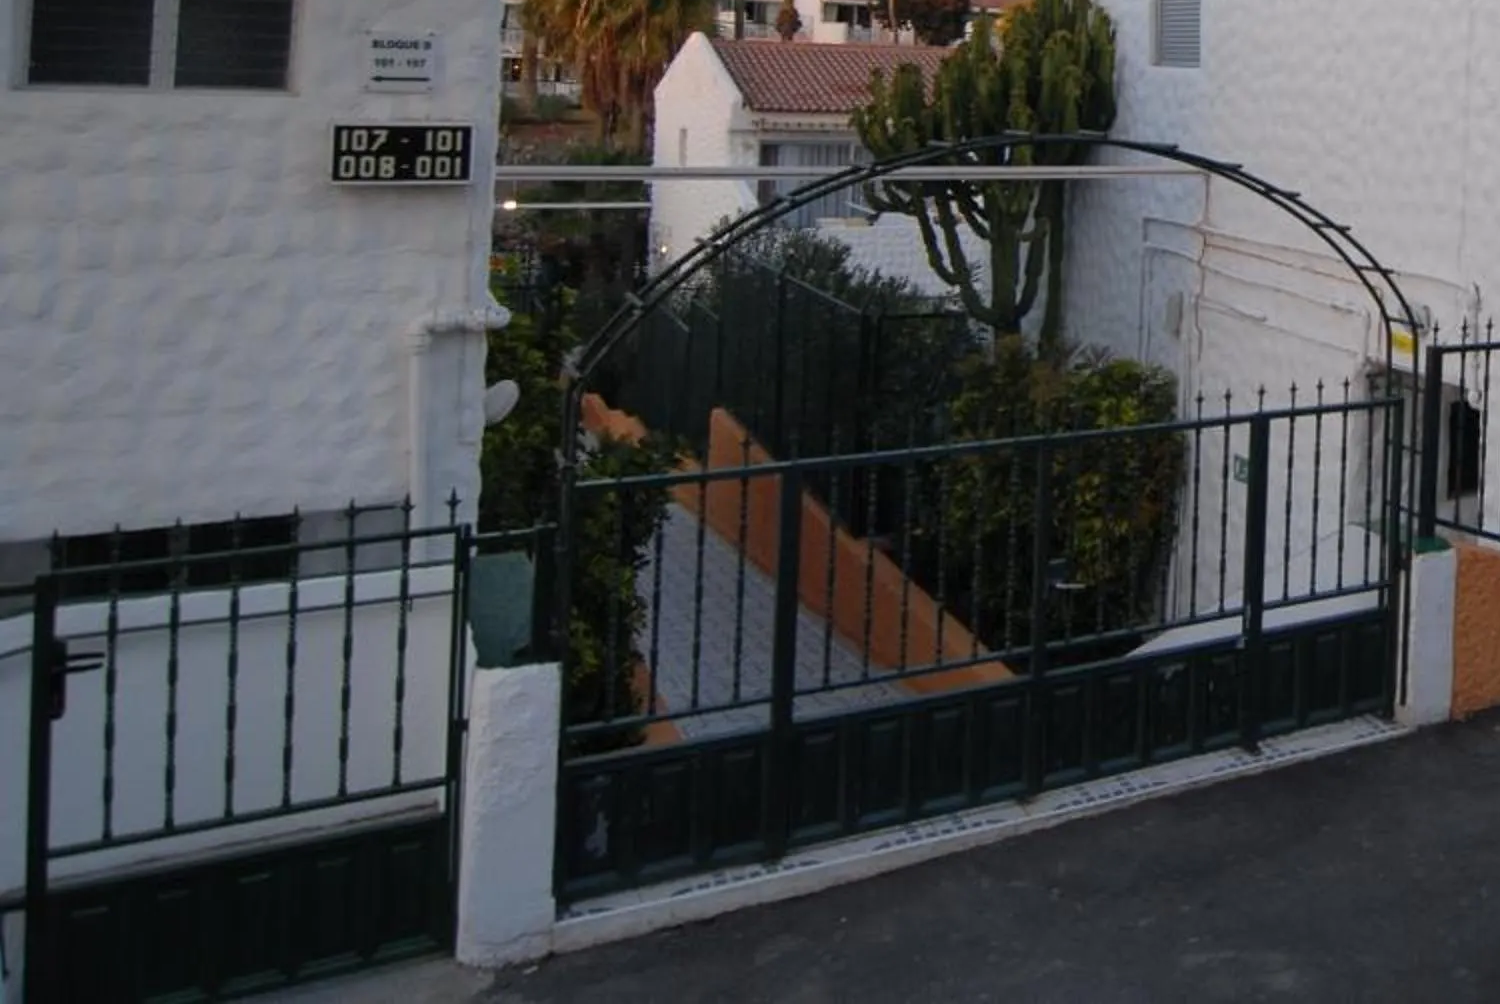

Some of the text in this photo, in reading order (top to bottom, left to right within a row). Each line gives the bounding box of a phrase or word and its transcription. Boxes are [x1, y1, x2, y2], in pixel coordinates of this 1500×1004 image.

[340, 129, 389, 151] 107
[425, 130, 463, 151] 101
[339, 155, 396, 178] 008
[415, 156, 462, 178] 001
